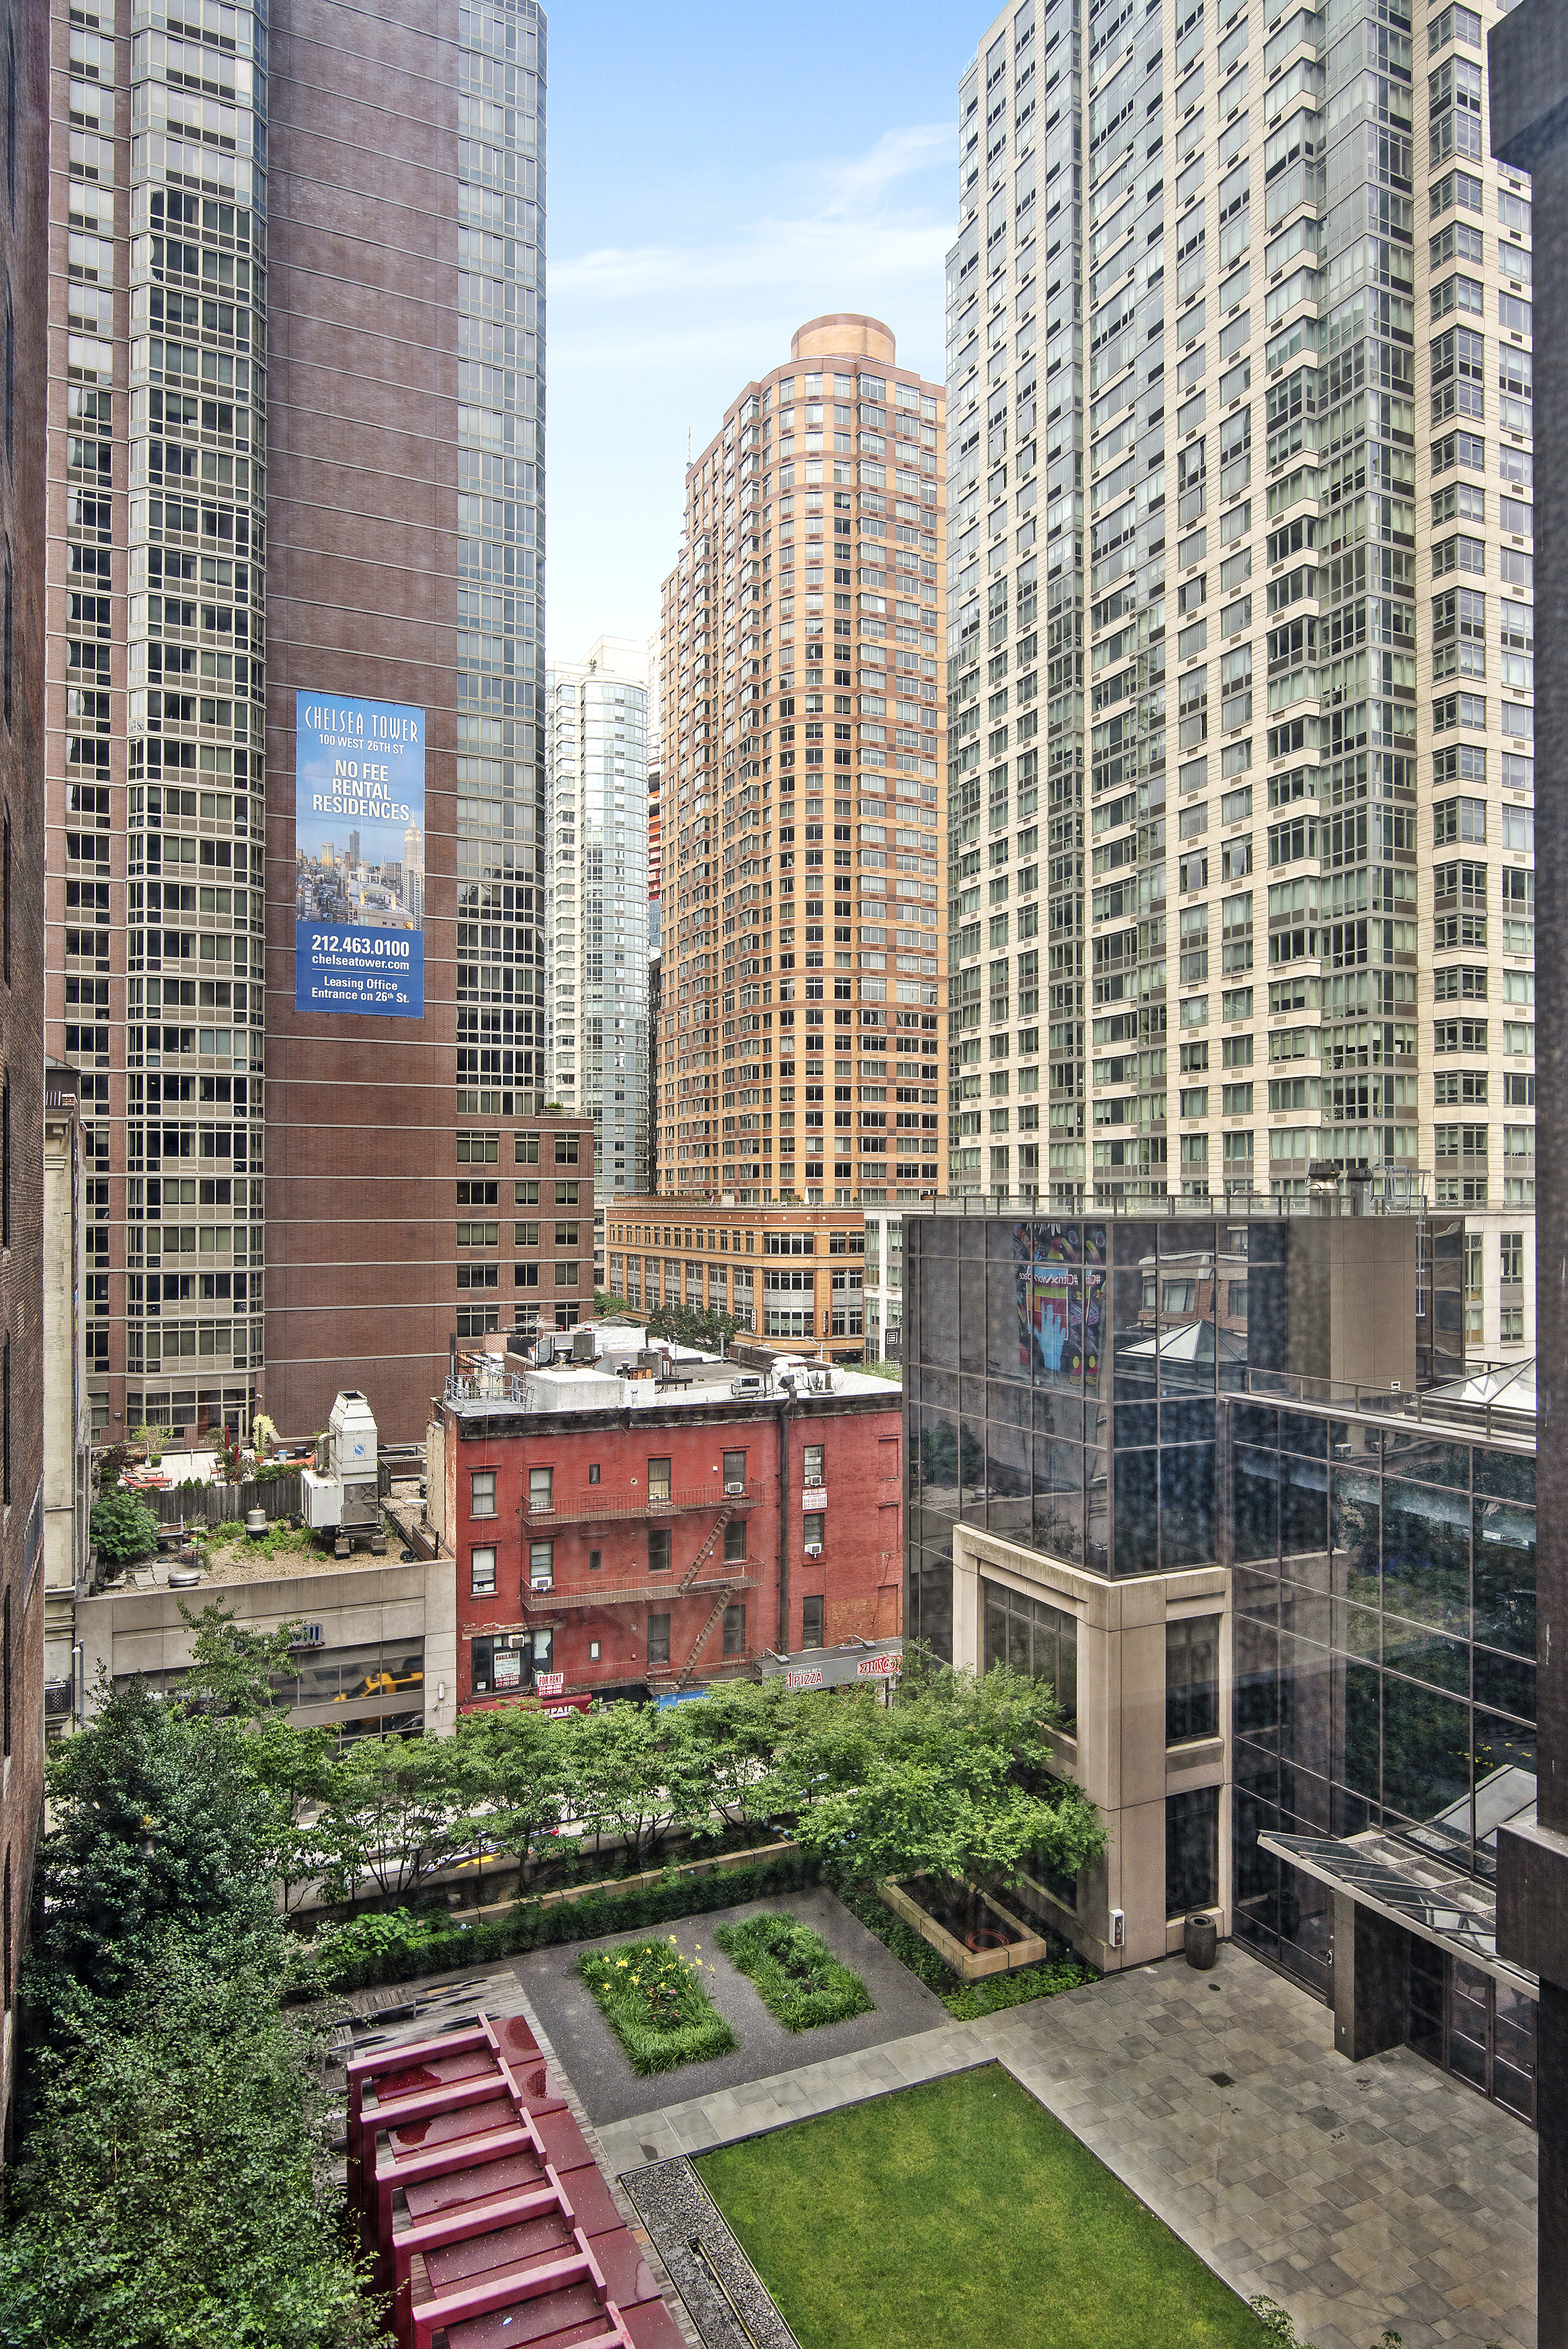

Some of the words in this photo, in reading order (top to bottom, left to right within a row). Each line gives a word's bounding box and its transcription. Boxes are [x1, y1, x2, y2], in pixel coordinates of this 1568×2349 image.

[305, 705, 363, 735] CHELSEA
[372, 714, 418, 743] TOWER
[319, 734, 335, 745] 100
[337, 737, 364, 749] WEST
[367, 740, 390, 753] 26TH
[393, 744, 404, 755] ST
[335, 759, 358, 778] NO
[362, 763, 389, 782] FEE
[332, 777, 391, 801] RENTAL
[313, 794, 410, 821] RESIDENCES
[312, 934, 410, 957] 212.463.0100
[312, 953, 410, 970] chelseatower.com
[324, 976, 364, 990] Leasing
[366, 978, 398, 990] Office
[312, 988, 357, 1000] Entrance
[361, 992, 373, 1001] on
[376, 992, 394, 1002] 26th
[396, 993, 410, 1003] St.
[495, 1652, 519, 1661] AVAILABLE
[539, 1676, 548, 1685] FOR
[549, 1675, 562, 1684] RENT
[793, 1672, 823, 1688] PIZZA
